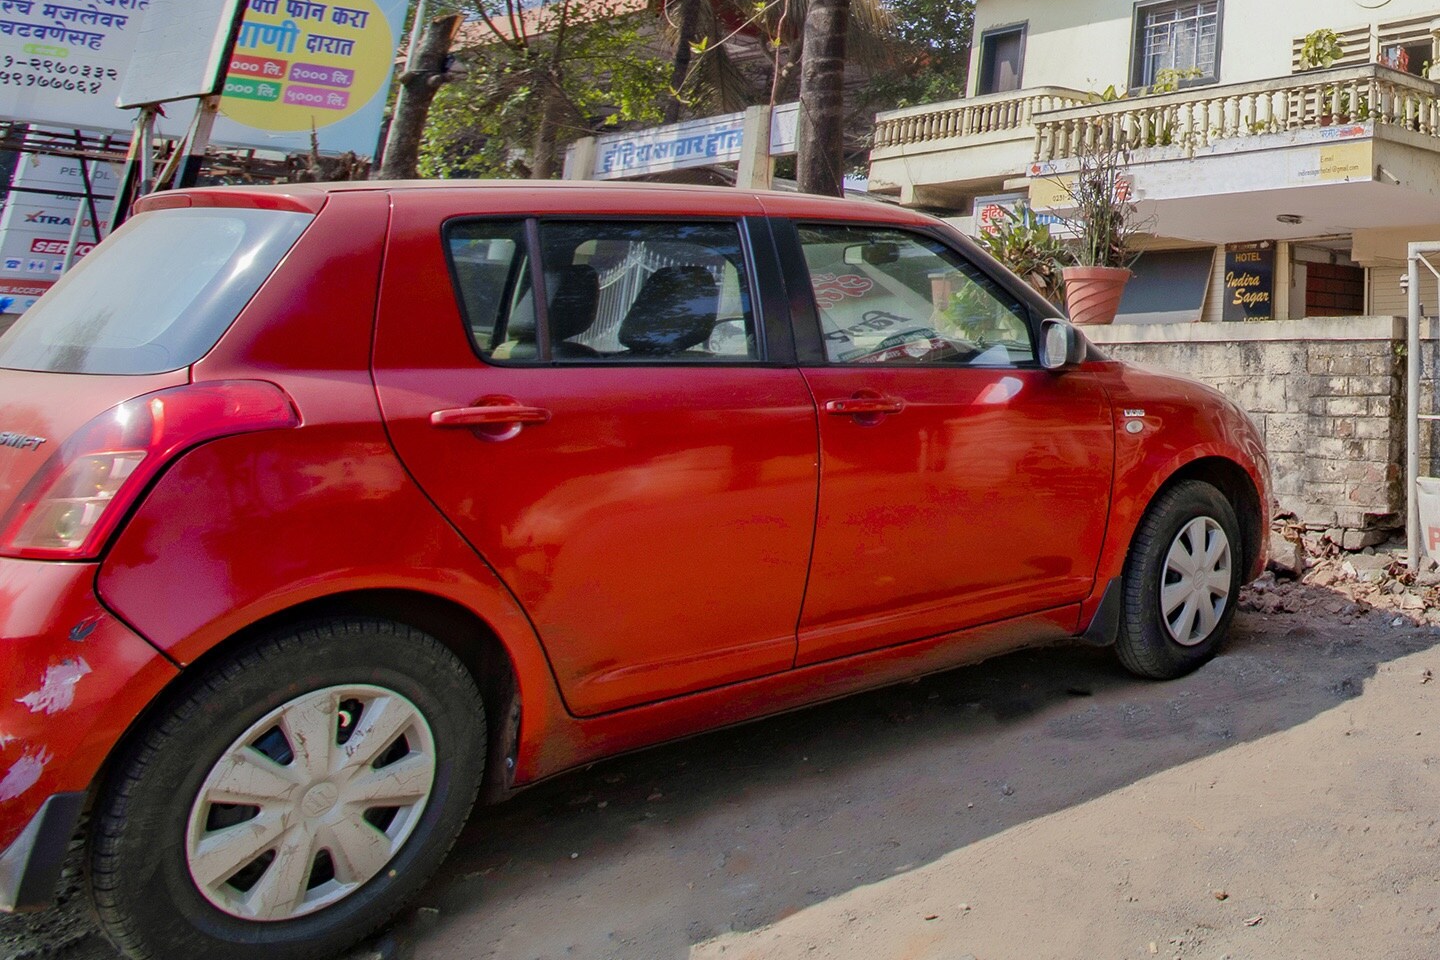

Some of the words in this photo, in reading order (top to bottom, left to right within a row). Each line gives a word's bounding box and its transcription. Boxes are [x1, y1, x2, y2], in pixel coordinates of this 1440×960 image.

[42, 3, 129, 30] मजलेवर
[331, 6, 369, 29] करा
[306, 34, 355, 56] दारात
[229, 60, 259, 73] ०००
[293, 67, 328, 81] २०००
[224, 82, 254, 95] ०००
[61, 166, 110, 180] PEOL
[1235, 252, 1261, 262] HOTEL
[1226, 271, 1260, 289] Indira
[1232, 288, 1270, 309] Sagar
